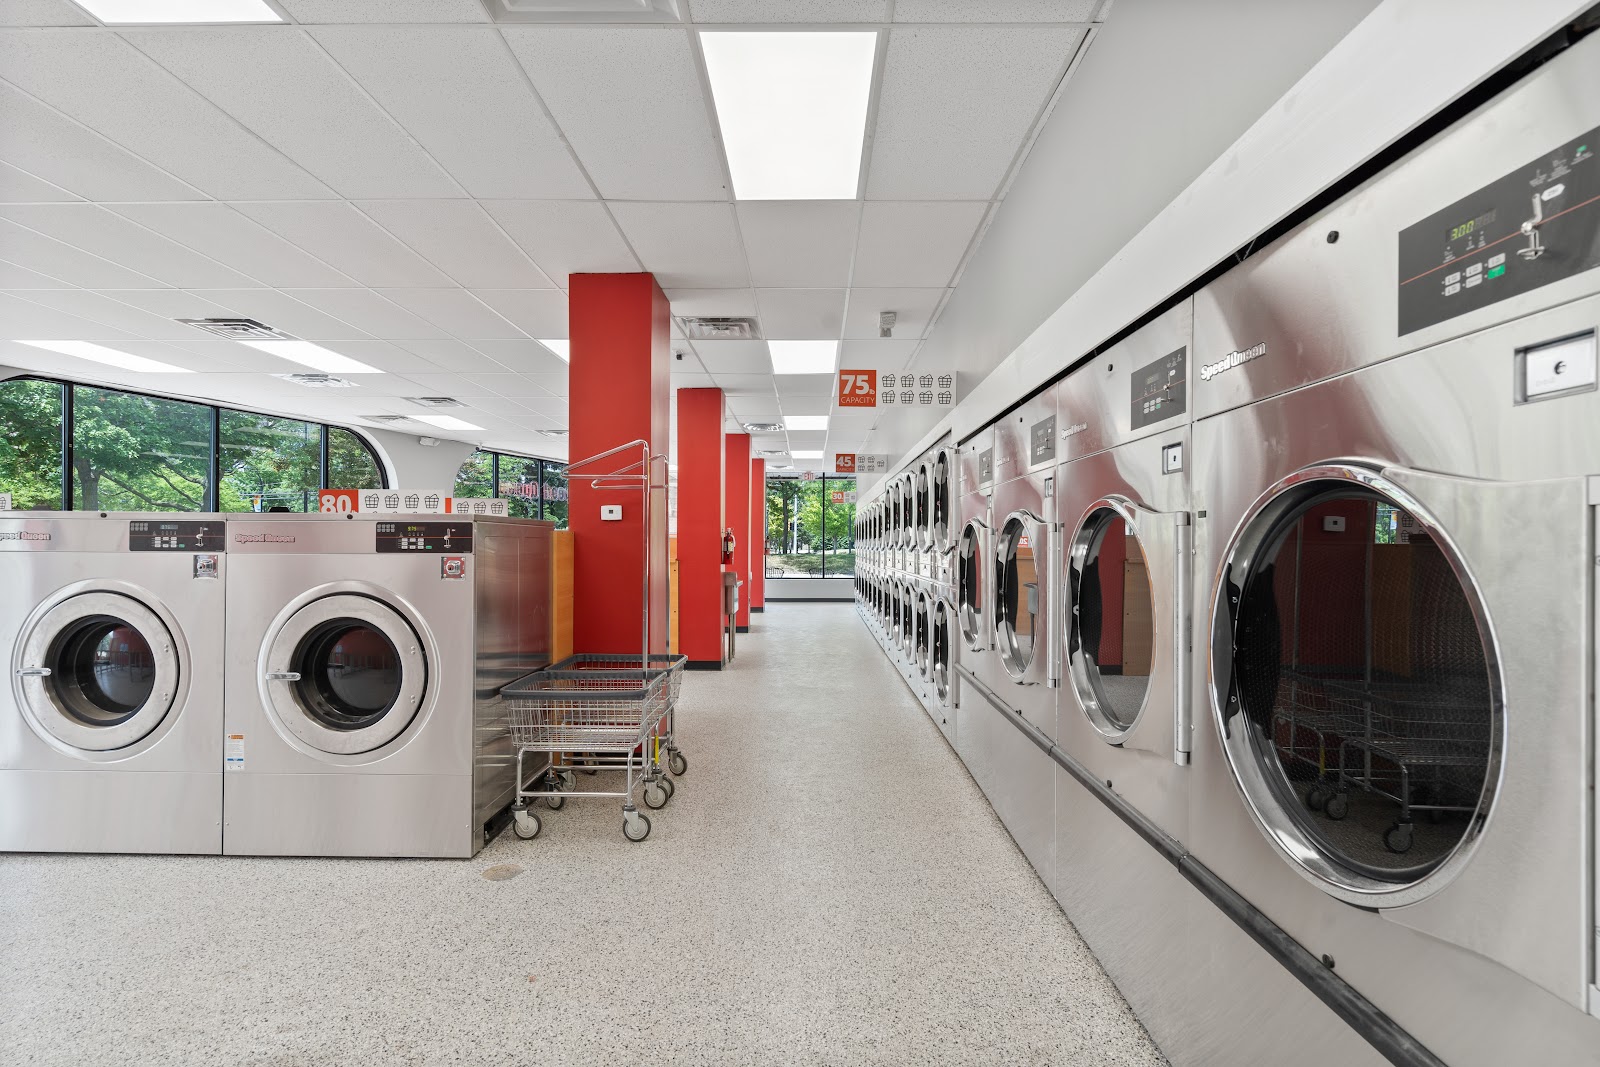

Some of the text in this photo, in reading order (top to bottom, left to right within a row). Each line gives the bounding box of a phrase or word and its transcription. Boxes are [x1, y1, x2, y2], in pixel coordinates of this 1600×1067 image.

[1200, 354, 1231, 381] Speed
[841, 374, 870, 395] 75
[840, 396, 875, 404] CAPACITY
[836, 456, 852, 467] 45
[803, 472, 815, 480] EXIT
[321, 494, 352, 513] 80
[0, 531, 51, 541] peed Queen
[235, 534, 266, 544] Speed
